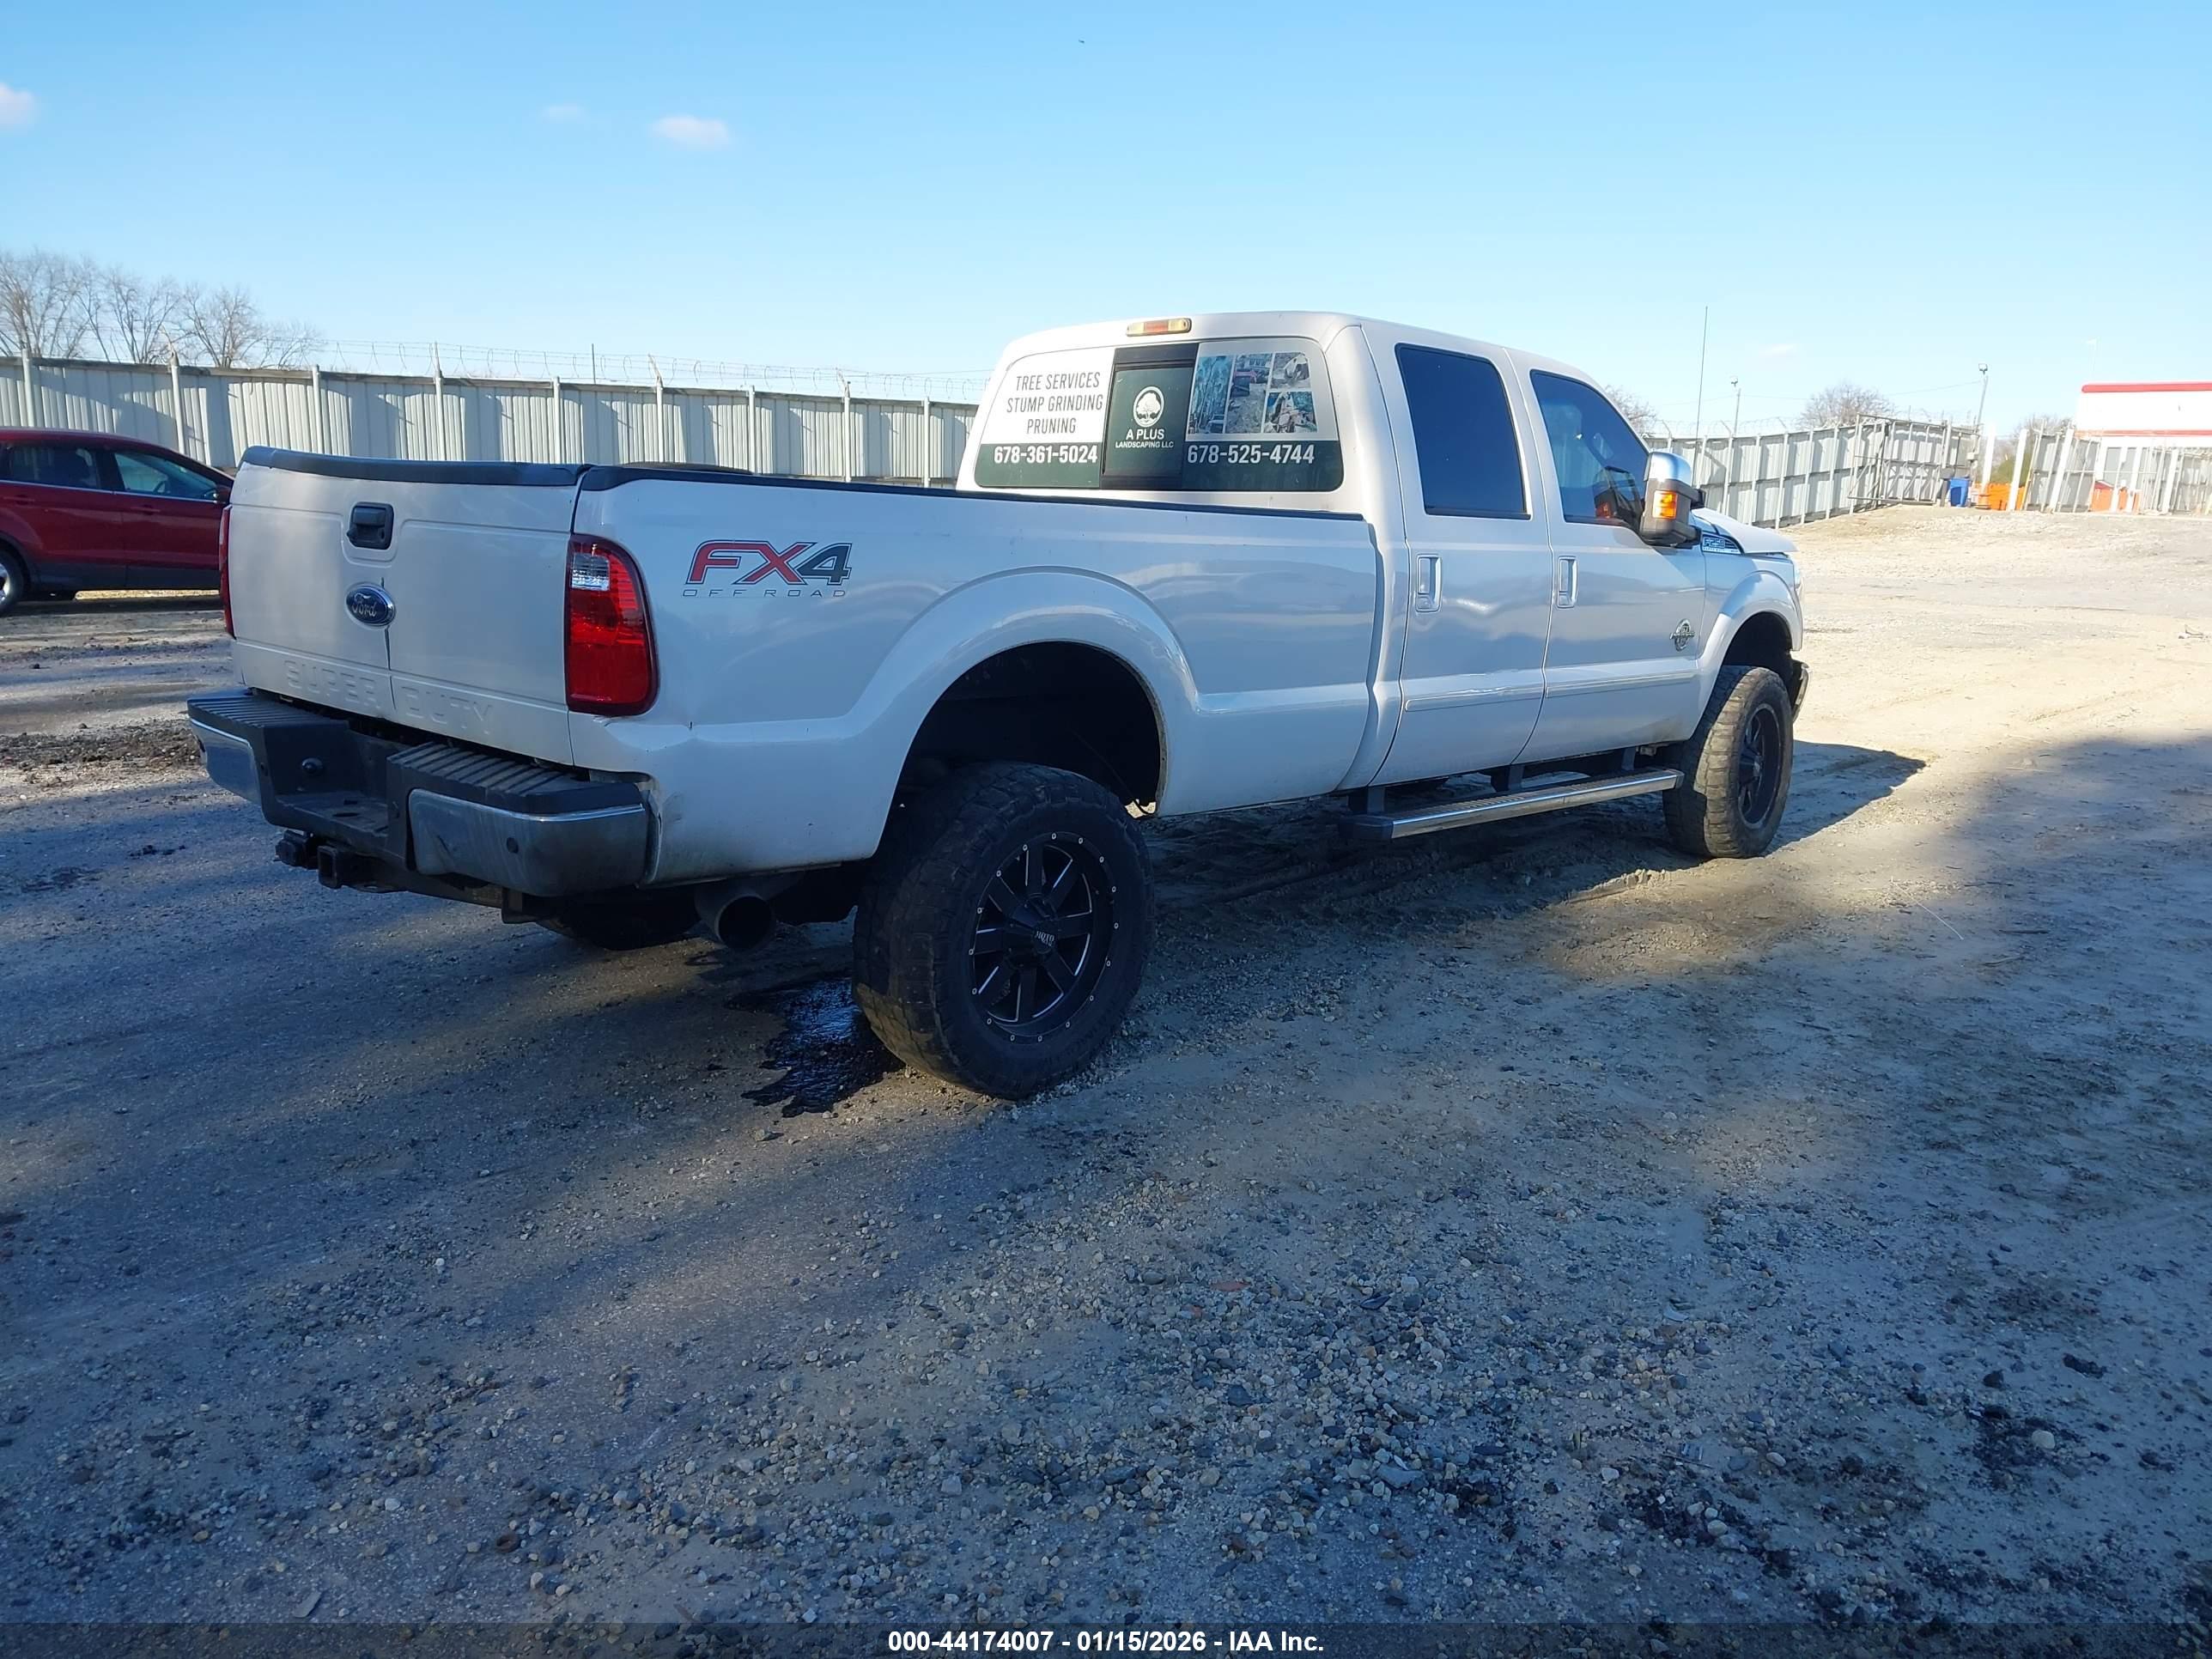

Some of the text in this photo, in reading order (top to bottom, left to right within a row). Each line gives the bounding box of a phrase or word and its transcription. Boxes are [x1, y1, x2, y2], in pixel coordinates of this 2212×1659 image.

[1016, 371, 1101, 392] TREE SERVICES
[1006, 393, 1103, 413] STUMP GRINDING
[1026, 417, 1077, 434] PRUNING
[1125, 428, 1164, 441] A PLUS
[994, 444, 1098, 464] 678-361-5024
[1115, 441, 1175, 449] LANDSCAPING LLC
[1187, 444, 1316, 465] 678-525-4744
[685, 539, 853, 586] FX4
[682, 589, 847, 598] OFF ROAD
[284, 659, 494, 736] SUPER DUTY
